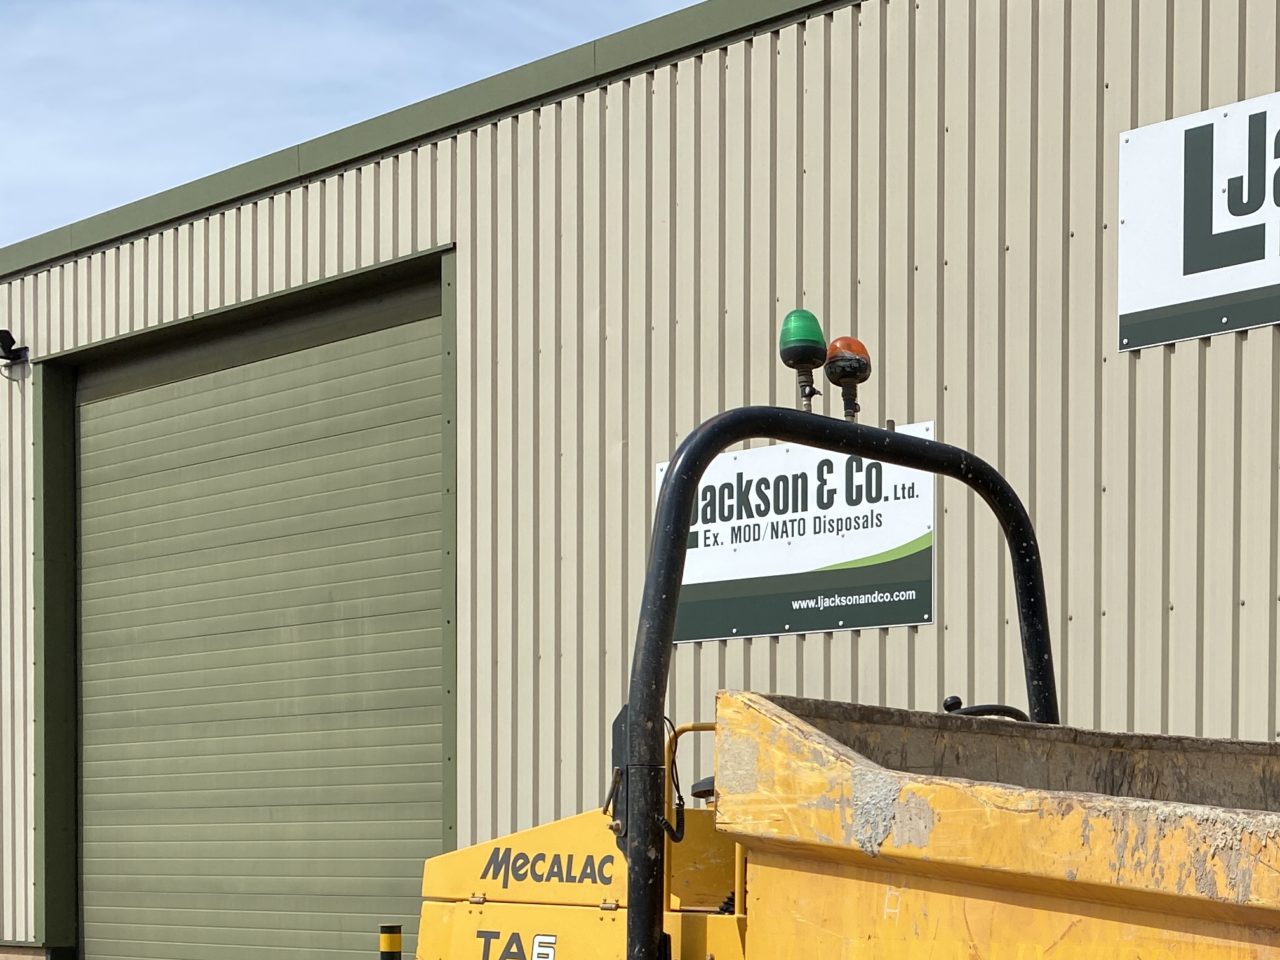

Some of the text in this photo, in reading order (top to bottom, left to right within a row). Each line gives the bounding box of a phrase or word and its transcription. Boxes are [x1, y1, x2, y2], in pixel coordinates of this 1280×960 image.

[815, 458, 838, 511] &
[844, 454, 890, 507] Co.
[893, 481, 920, 502] Ltd.
[703, 508, 884, 548] Ex. MOD/NATO Disposals
[791, 588, 917, 611] www.ljacksonandco.com
